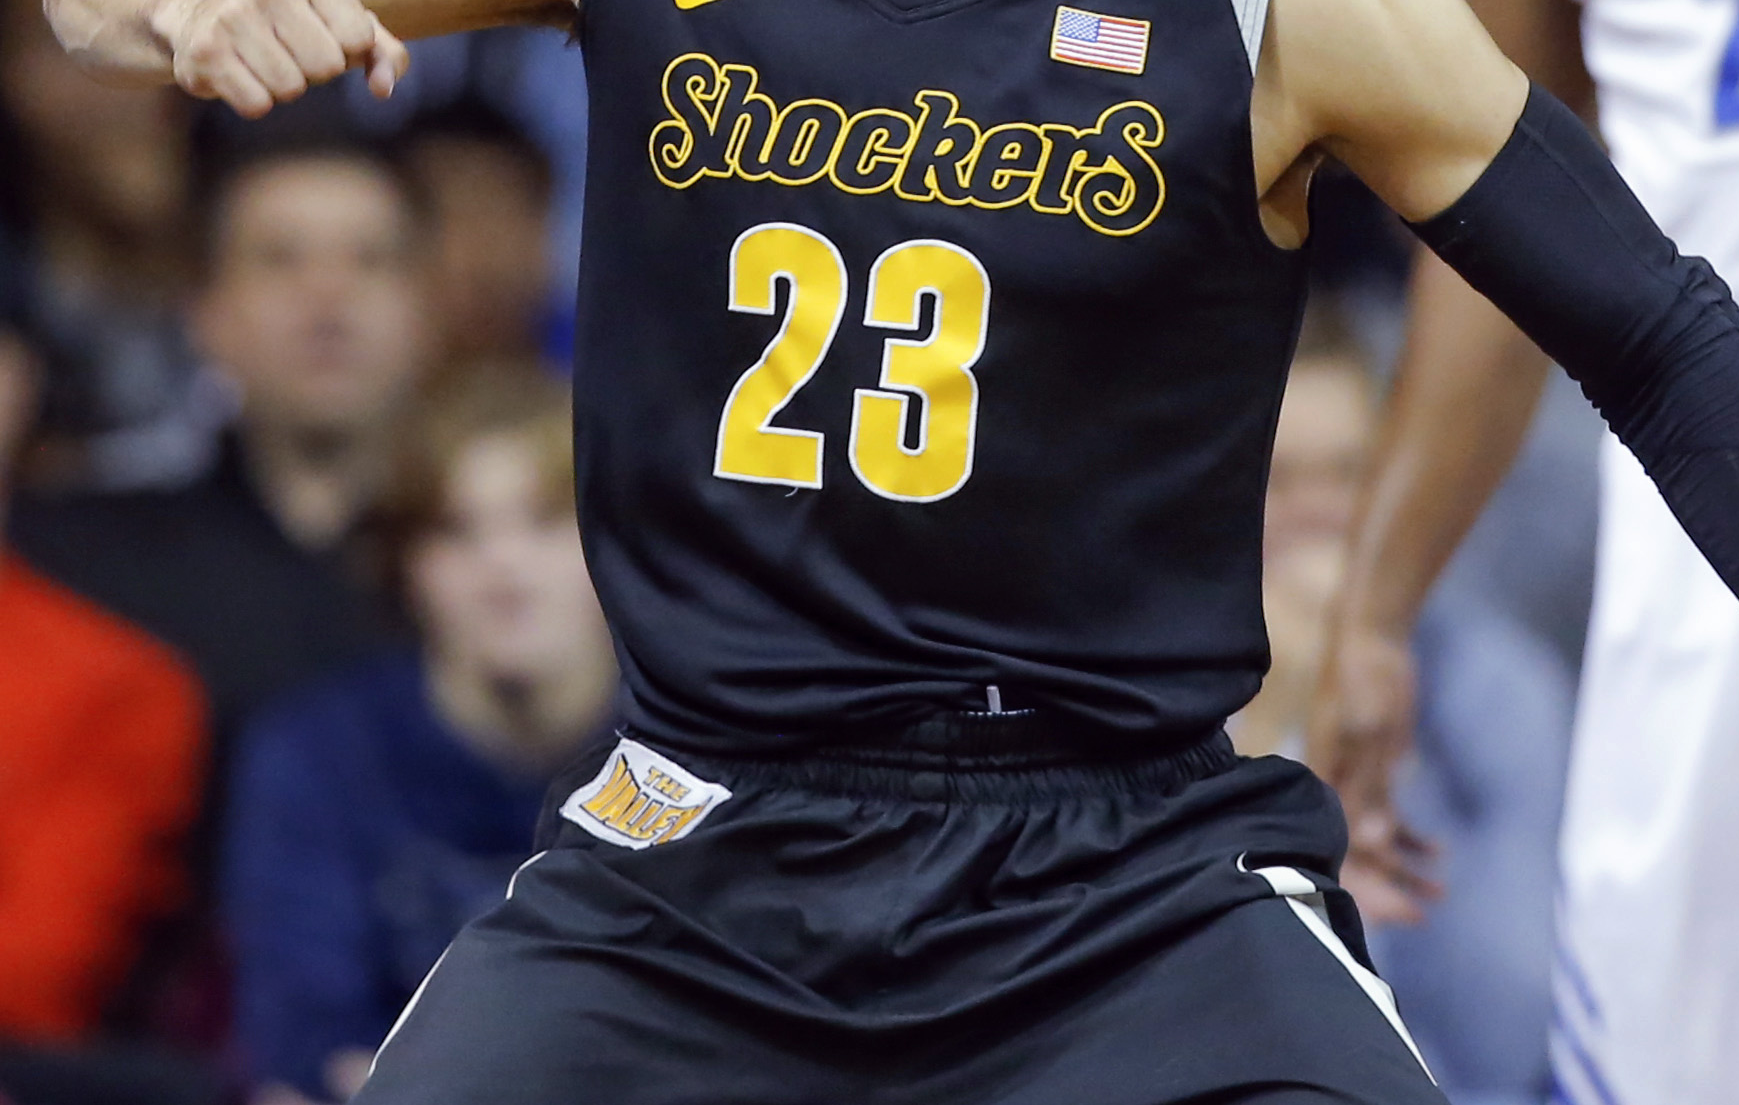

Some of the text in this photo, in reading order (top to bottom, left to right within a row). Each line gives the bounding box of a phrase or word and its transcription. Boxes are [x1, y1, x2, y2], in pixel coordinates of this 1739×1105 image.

[713, 221, 992, 503] 23
[579, 753, 714, 845] VALLEY
[643, 765, 691, 802] THE
